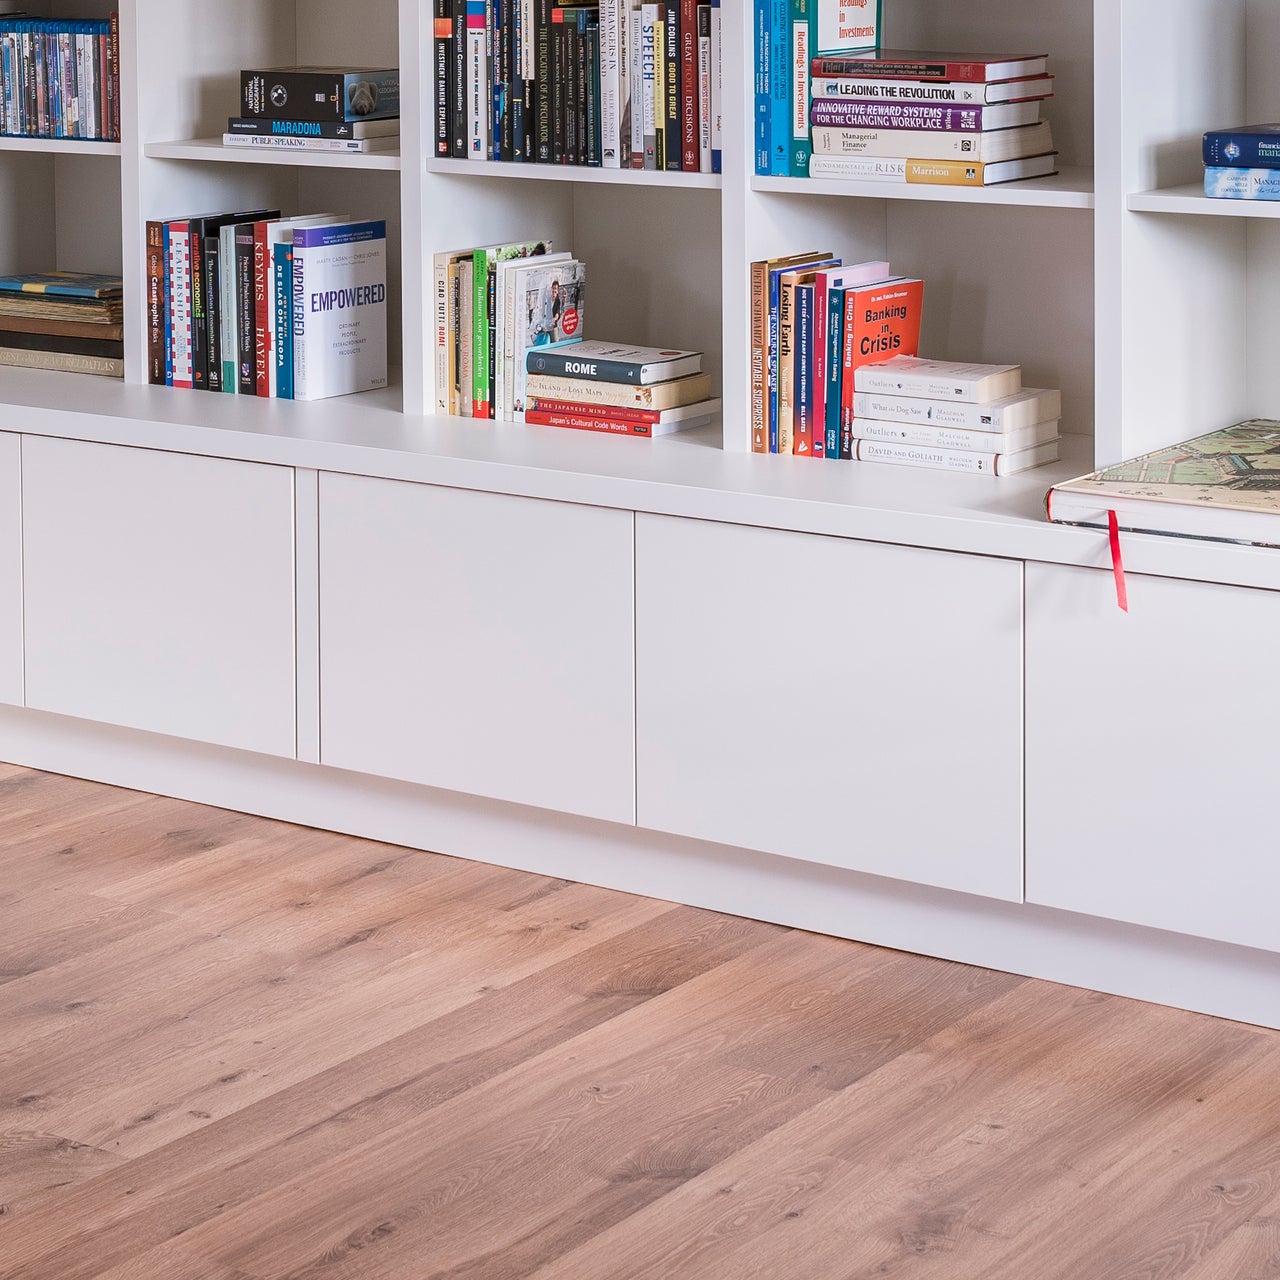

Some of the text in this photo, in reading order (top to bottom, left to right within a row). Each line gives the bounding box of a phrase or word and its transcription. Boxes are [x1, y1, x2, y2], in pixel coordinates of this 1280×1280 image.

[840, 27, 874, 38] Investments
[643, 26, 654, 80] SPEECH
[797, 32, 805, 129] Readings in Investments
[669, 85, 676, 93] TO
[840, 85, 955, 100] LEADING THE REVOLUTION
[817, 103, 941, 117] INNOVATIVE REWARD SYSTEMS
[272, 122, 321, 135] MARADONA
[846, 116, 889, 126] CHANGING
[890, 117, 941, 128] WORKPLACE
[256, 242, 264, 301] KEYNES
[277, 266, 283, 278] DE
[293, 258, 304, 335] EMPOWERED
[311, 284, 385, 312] EMPOWERED
[782, 283, 791, 356] Losing Earth
[866, 305, 907, 322] Banking
[882, 323, 889, 333] in
[860, 333, 900, 355] Crisis
[565, 362, 597, 375] ROME
[753, 348, 763, 429] INEVITABLE SURPRISES
[549, 416, 569, 424] Japan's
[571, 419, 592, 427] Cultural
